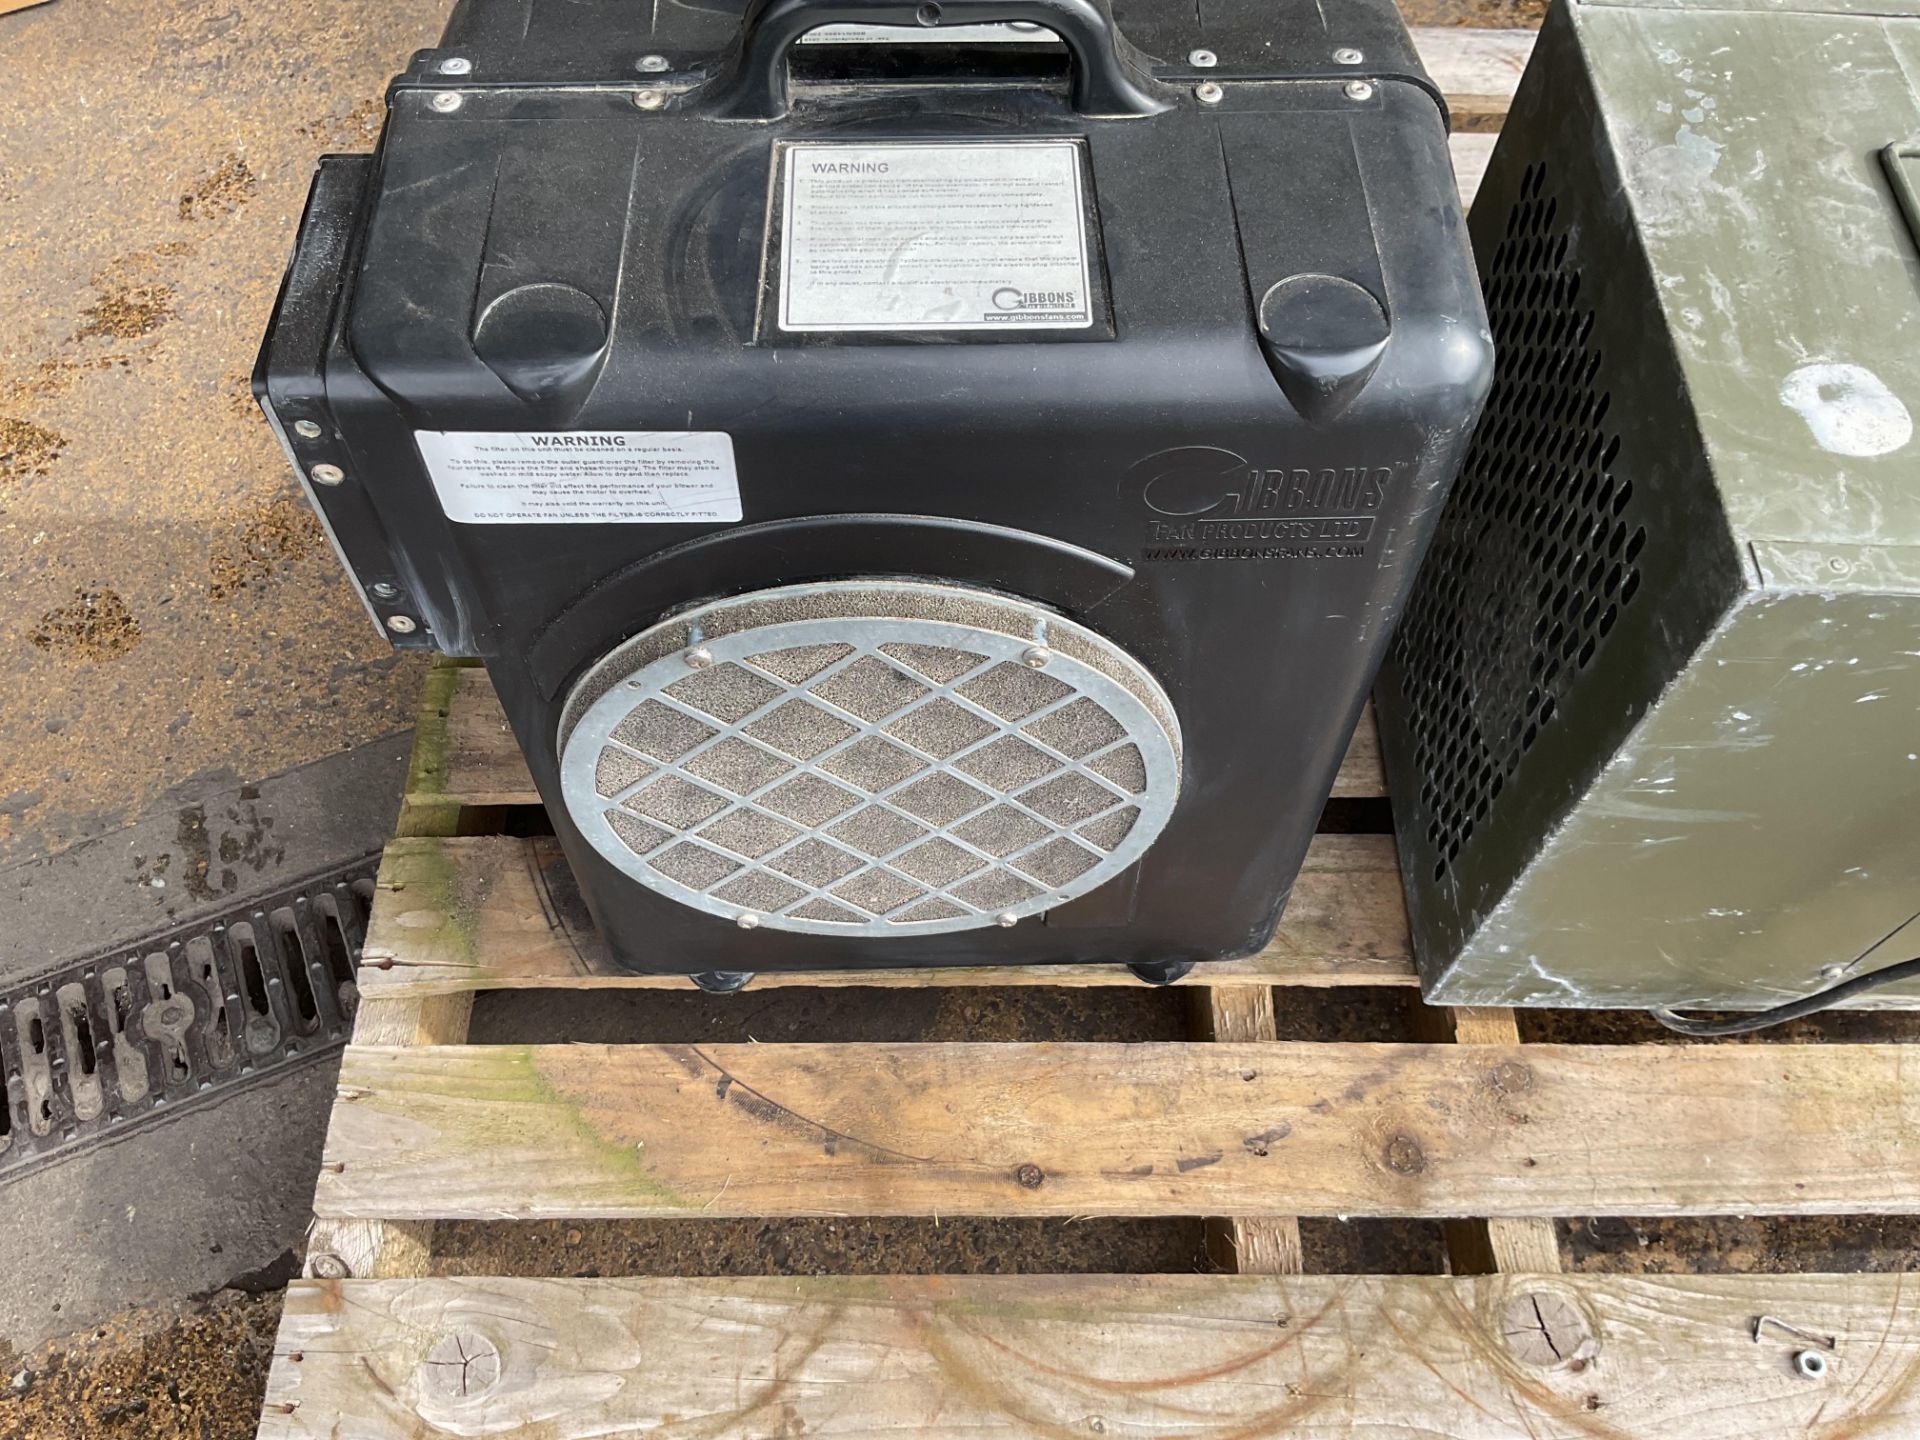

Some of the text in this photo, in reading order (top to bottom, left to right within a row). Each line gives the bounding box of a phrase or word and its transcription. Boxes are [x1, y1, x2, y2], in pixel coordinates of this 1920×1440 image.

[812, 162, 889, 173] WARNING
[992, 287, 1074, 310] GIBBONS
[986, 313, 1084, 321] www.gibbonsfans.com
[531, 436, 626, 446] WARNING
[1117, 445, 1392, 516] GIBBONS
[1150, 520, 1362, 541] FAN PRODUCTS LTD
[1143, 546, 1366, 563] WWW.GIBBONSFANS.COM
